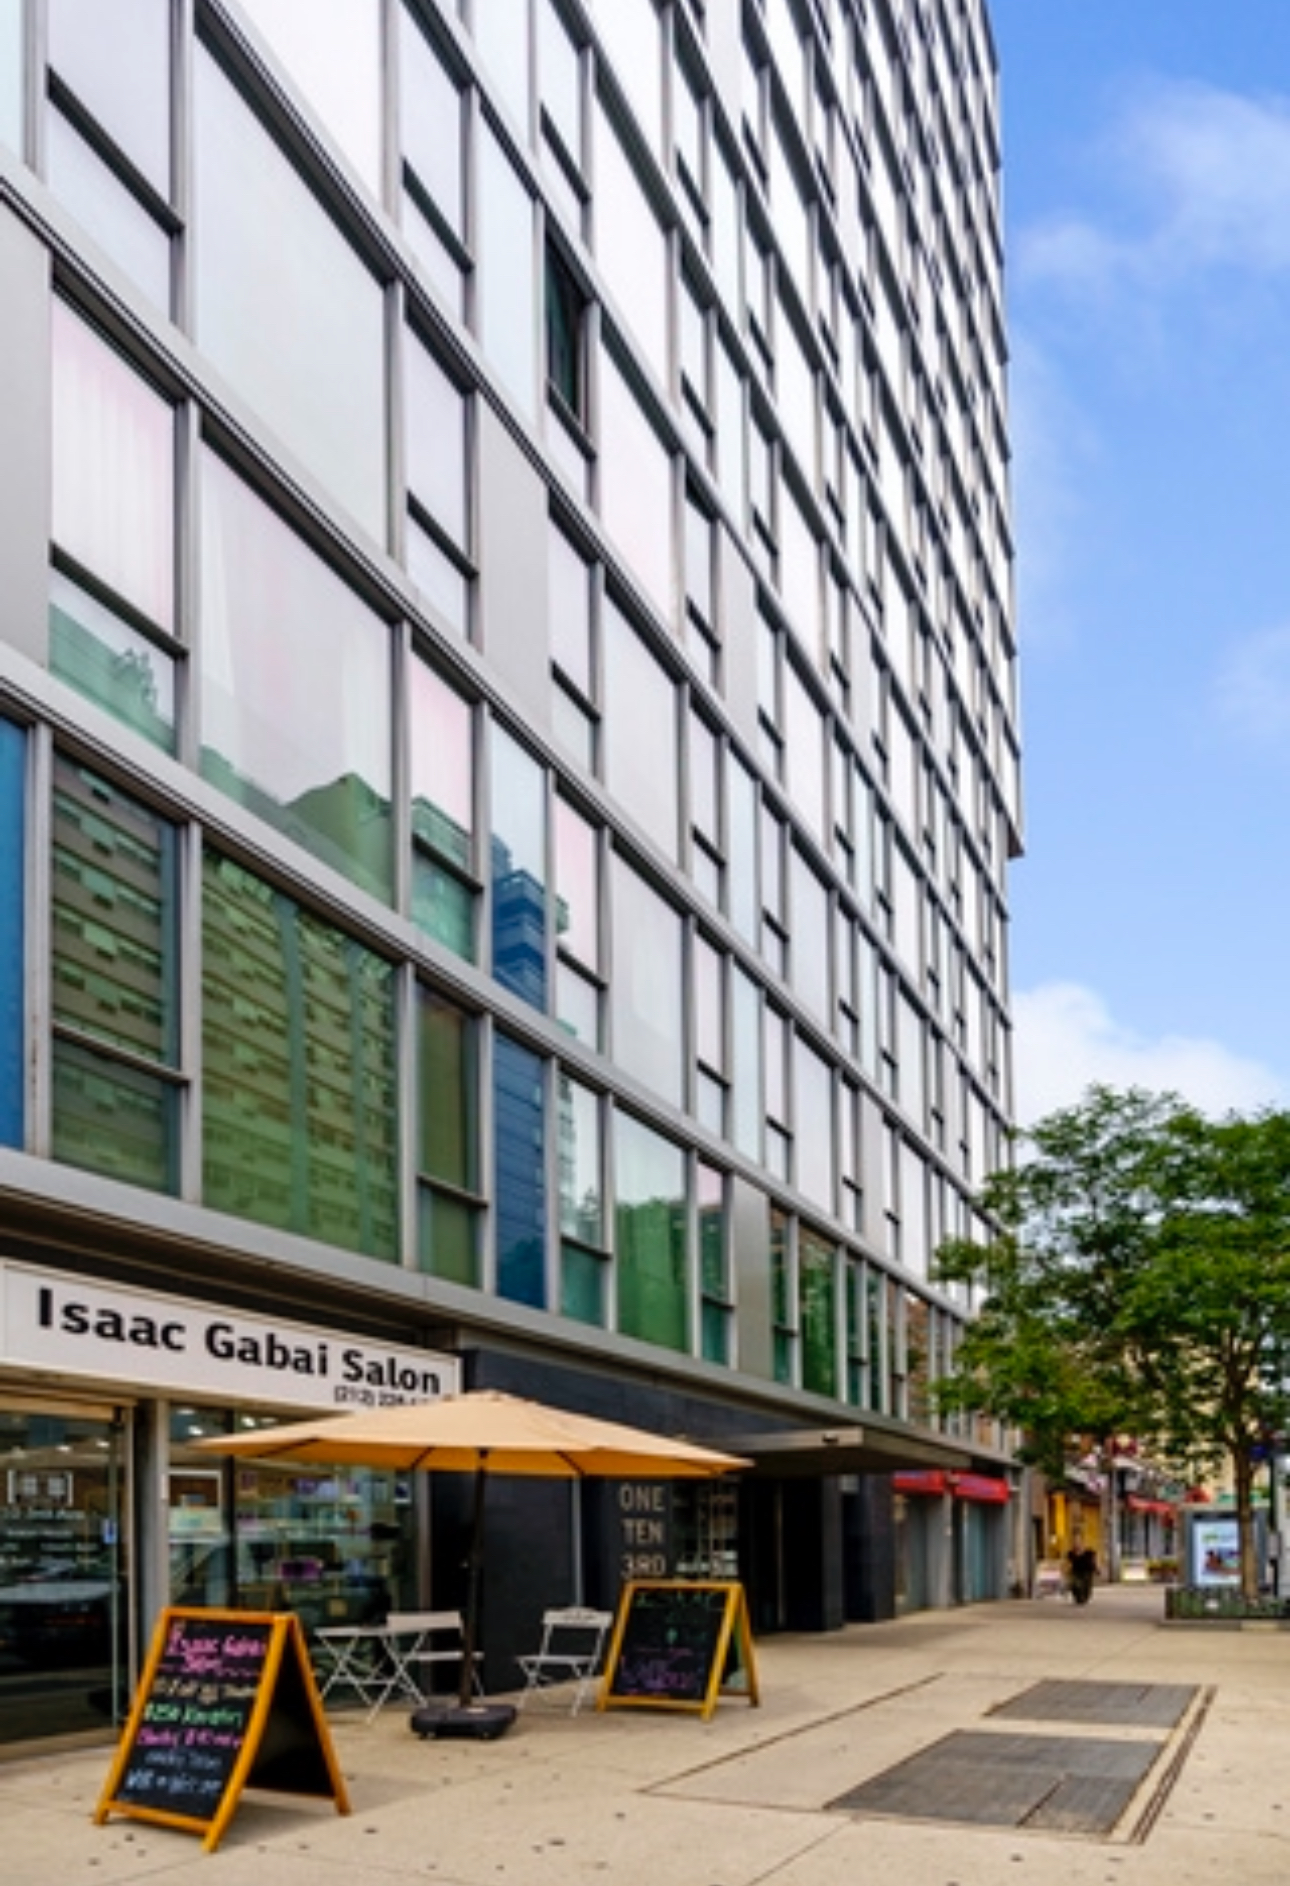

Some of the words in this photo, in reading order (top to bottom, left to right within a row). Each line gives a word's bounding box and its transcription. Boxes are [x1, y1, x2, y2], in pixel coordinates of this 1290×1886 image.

[39, 1287, 186, 1351] Isaac
[204, 1323, 328, 1376] Gabai
[341, 1349, 440, 1395] Salon
[620, 1484, 666, 1511] ONE
[622, 1519, 664, 1545] TEN
[621, 1554, 666, 1579] 3RD
